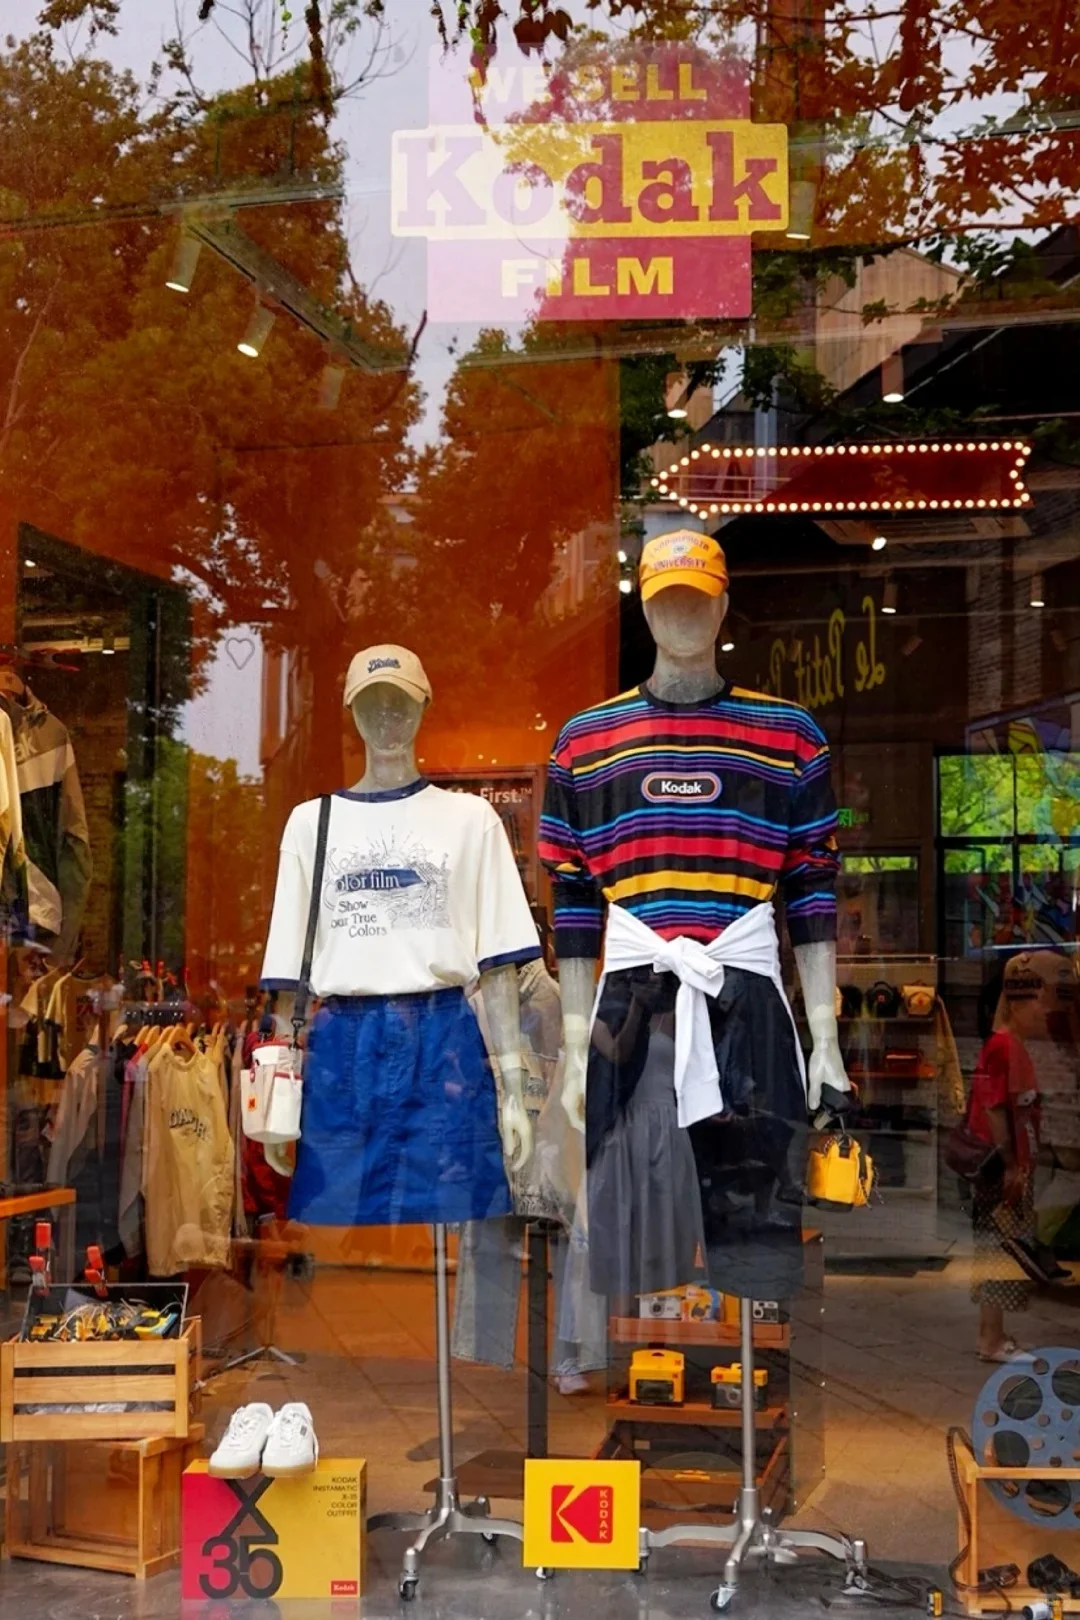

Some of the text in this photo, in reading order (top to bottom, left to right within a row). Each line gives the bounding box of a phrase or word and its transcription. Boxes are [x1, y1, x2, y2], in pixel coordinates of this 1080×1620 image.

[470, 63, 707, 103] WE SELL
[397, 131, 782, 227] Kodak
[501, 256, 675, 297] FILM
[661, 780, 702, 794] Kodak
[371, 870, 400, 889] film
[338, 900, 369, 913] Show
[351, 912, 377, 924] True
[348, 924, 387, 938] Colors
[326, 1509, 357, 1517] OUTFIT
[330, 1501, 357, 1509] COLOR
[599, 1489, 609, 1540] KODAK
[199, 1535, 283, 1599] 35
